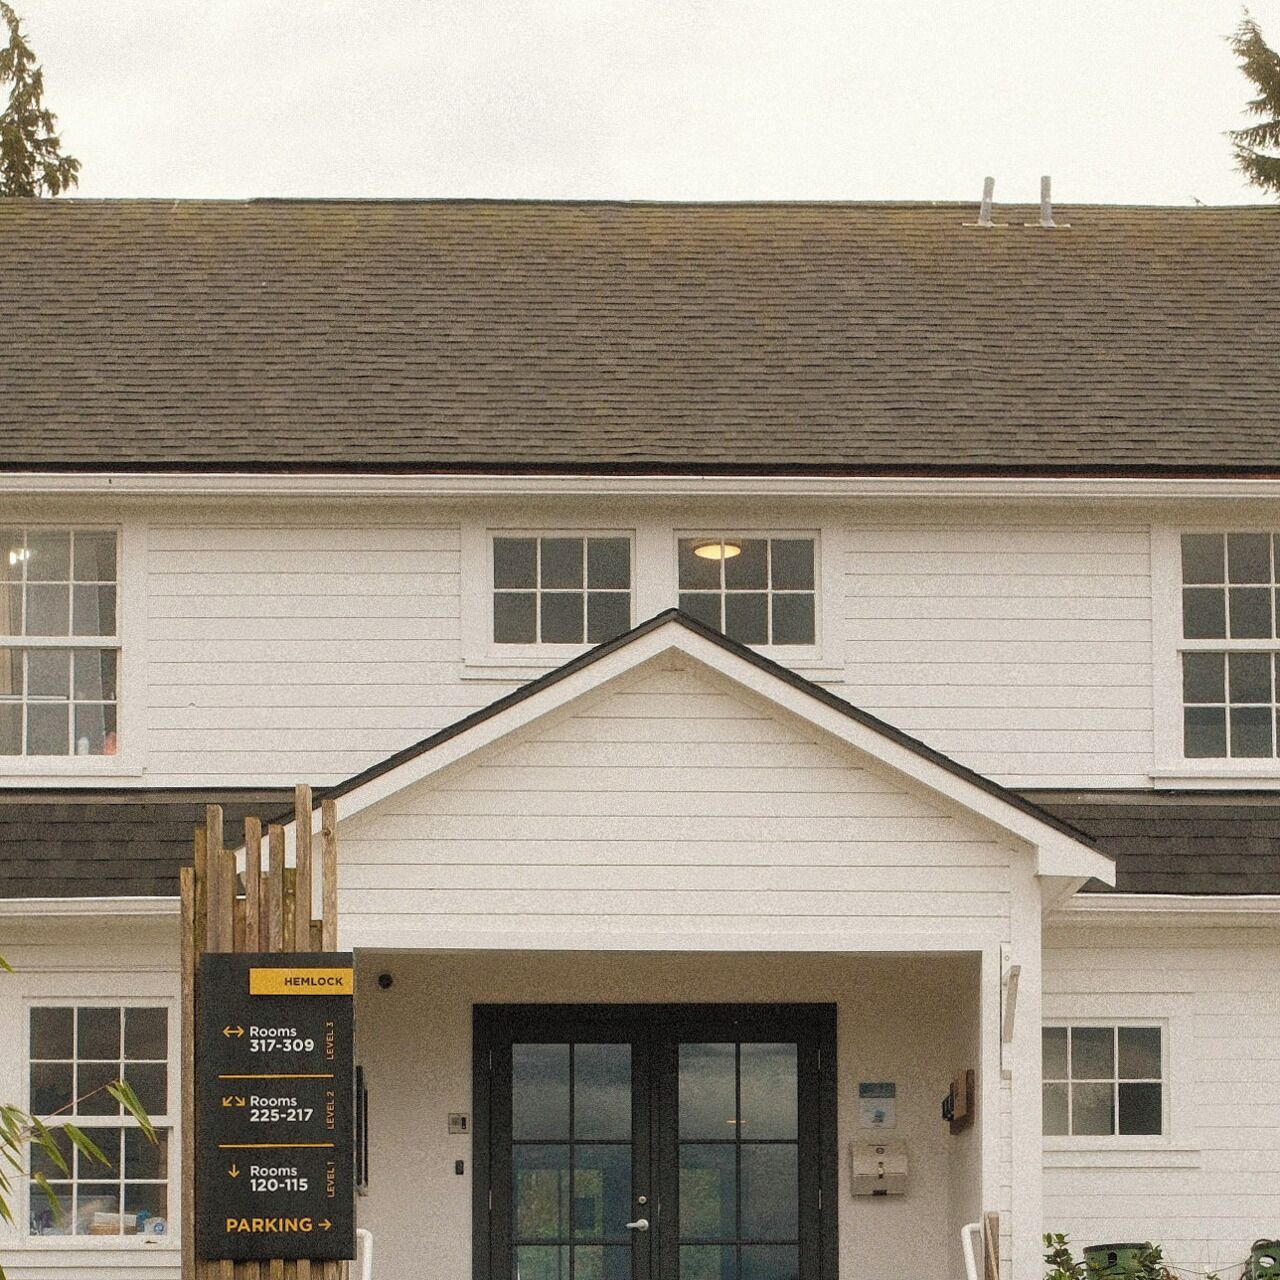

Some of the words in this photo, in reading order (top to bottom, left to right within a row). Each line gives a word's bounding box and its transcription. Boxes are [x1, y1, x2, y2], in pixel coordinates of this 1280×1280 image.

[284, 977, 344, 986] HEMLOCK
[249, 1026, 297, 1037] Rooms
[249, 1039, 315, 1052] 317-309
[326, 1029, 334, 1060] LEVEL
[250, 1095, 297, 1107] Rooms
[250, 1108, 314, 1122] 225-217
[326, 1099, 335, 1130] LEVEL
[250, 1165, 298, 1177] Rooms
[250, 1178, 308, 1192] 120-115
[326, 1168, 335, 1198] LEVEL
[226, 1218, 313, 1233] PARKING
